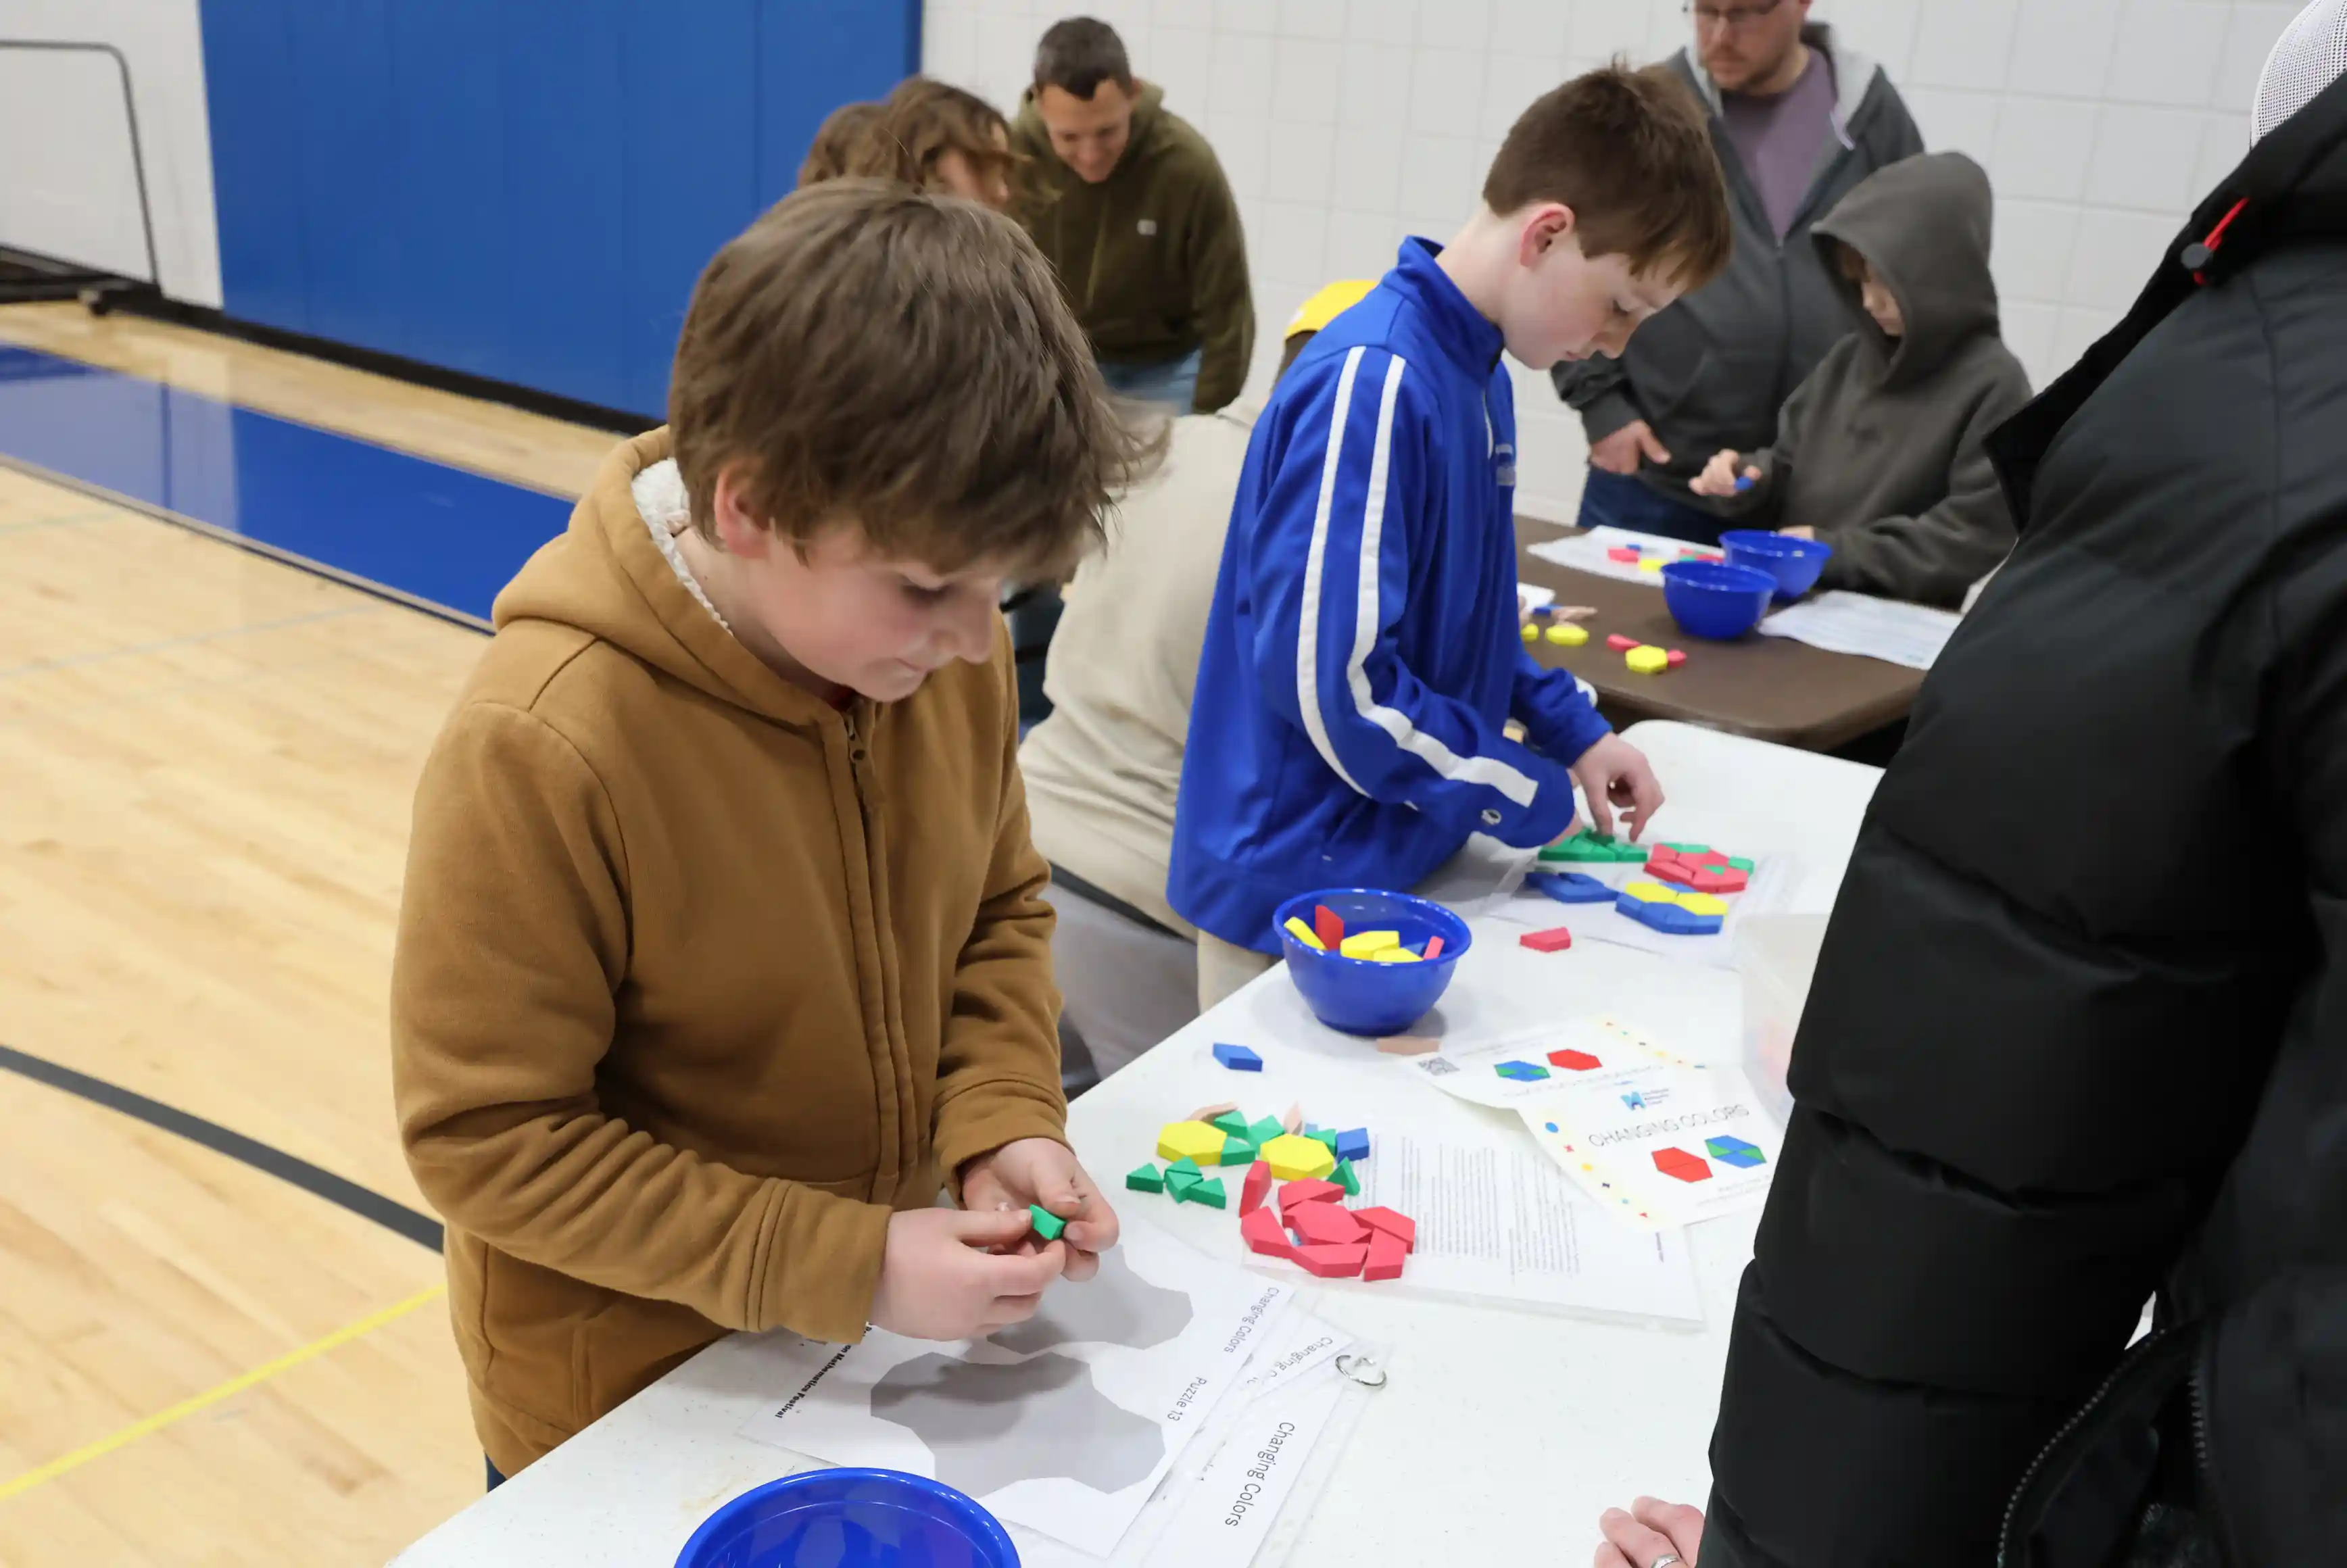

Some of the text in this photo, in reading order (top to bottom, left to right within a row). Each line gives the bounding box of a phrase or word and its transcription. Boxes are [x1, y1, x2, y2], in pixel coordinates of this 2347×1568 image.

[1224, 1287, 1280, 1353] Changing Colors
[1274, 1337, 1333, 1371] Changing
[1167, 1377, 1207, 1421] Puzzle 13
[1225, 1421, 1295, 1527] Changing Colors
